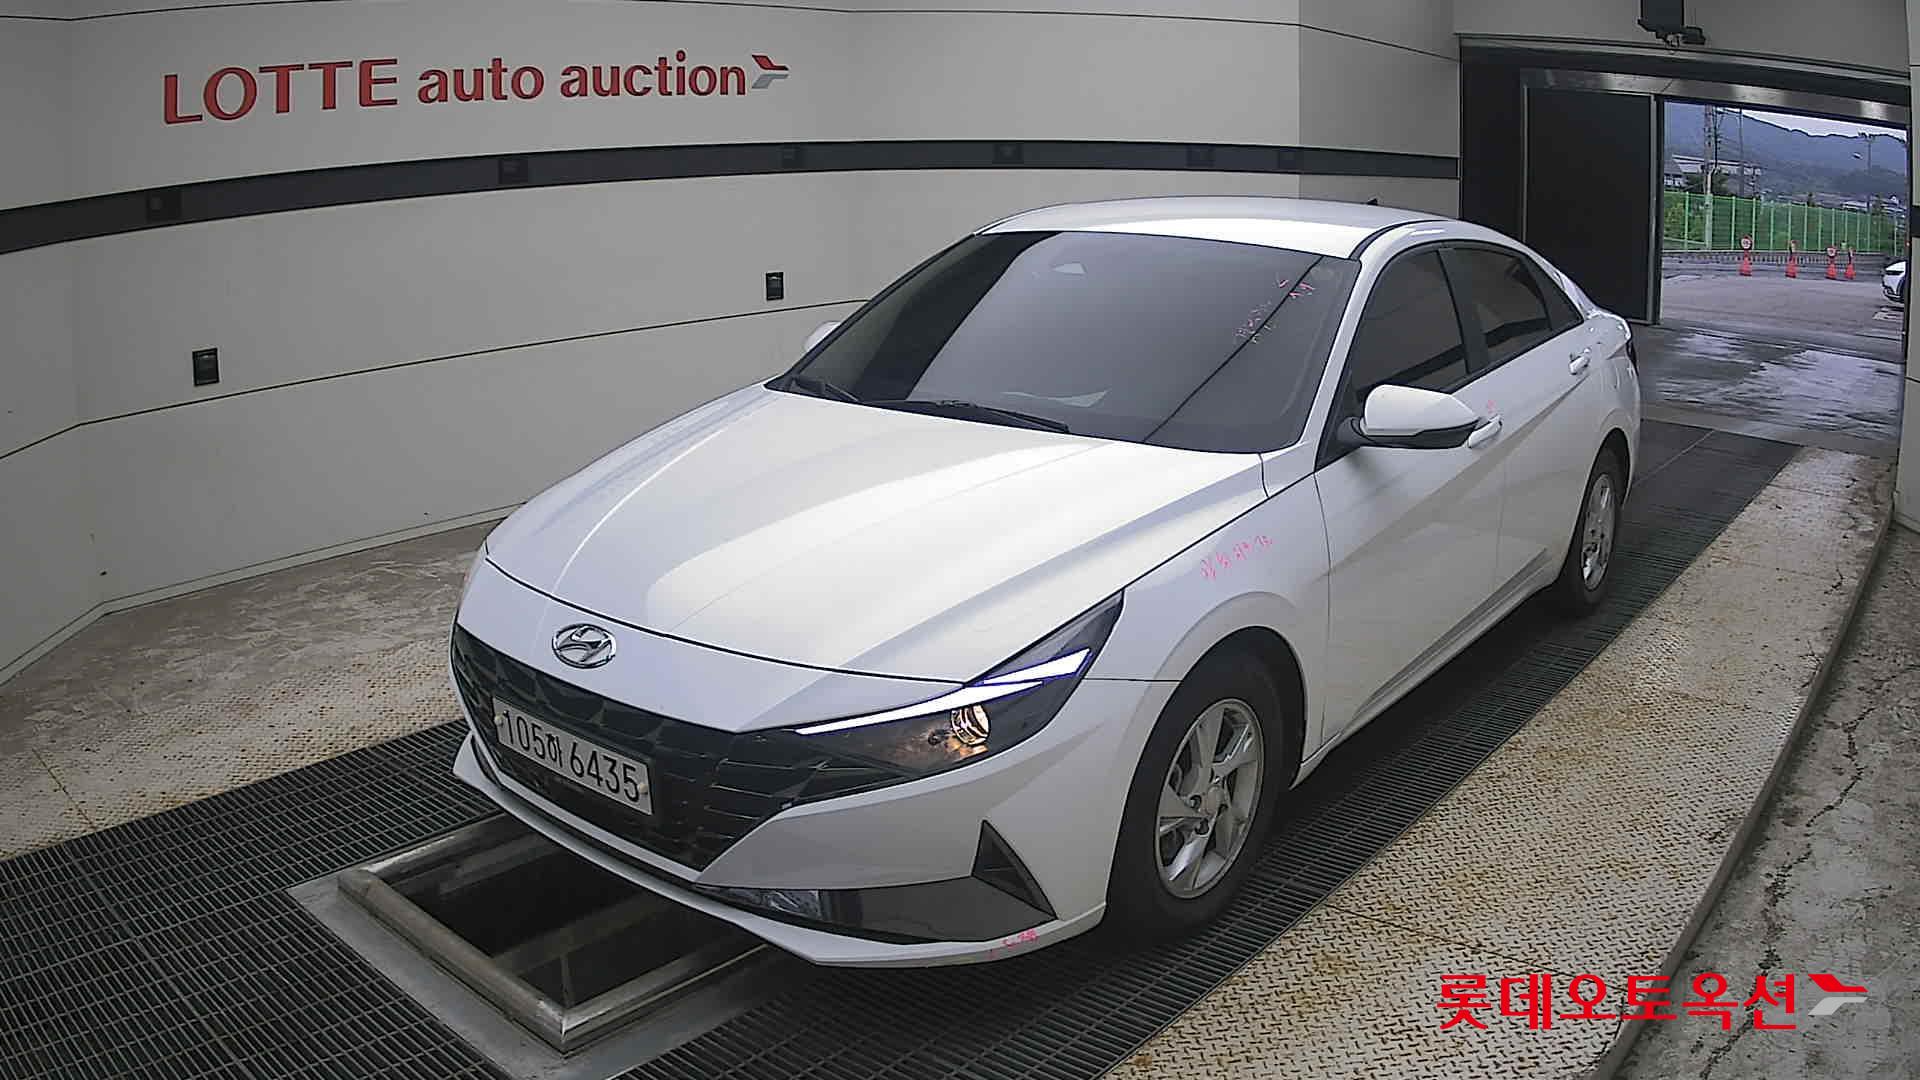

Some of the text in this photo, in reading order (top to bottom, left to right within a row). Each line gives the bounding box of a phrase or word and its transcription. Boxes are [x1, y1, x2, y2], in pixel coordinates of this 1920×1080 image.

[163, 49, 747, 125] LOTTE auto auction
[570, 741, 640, 803] 6435
